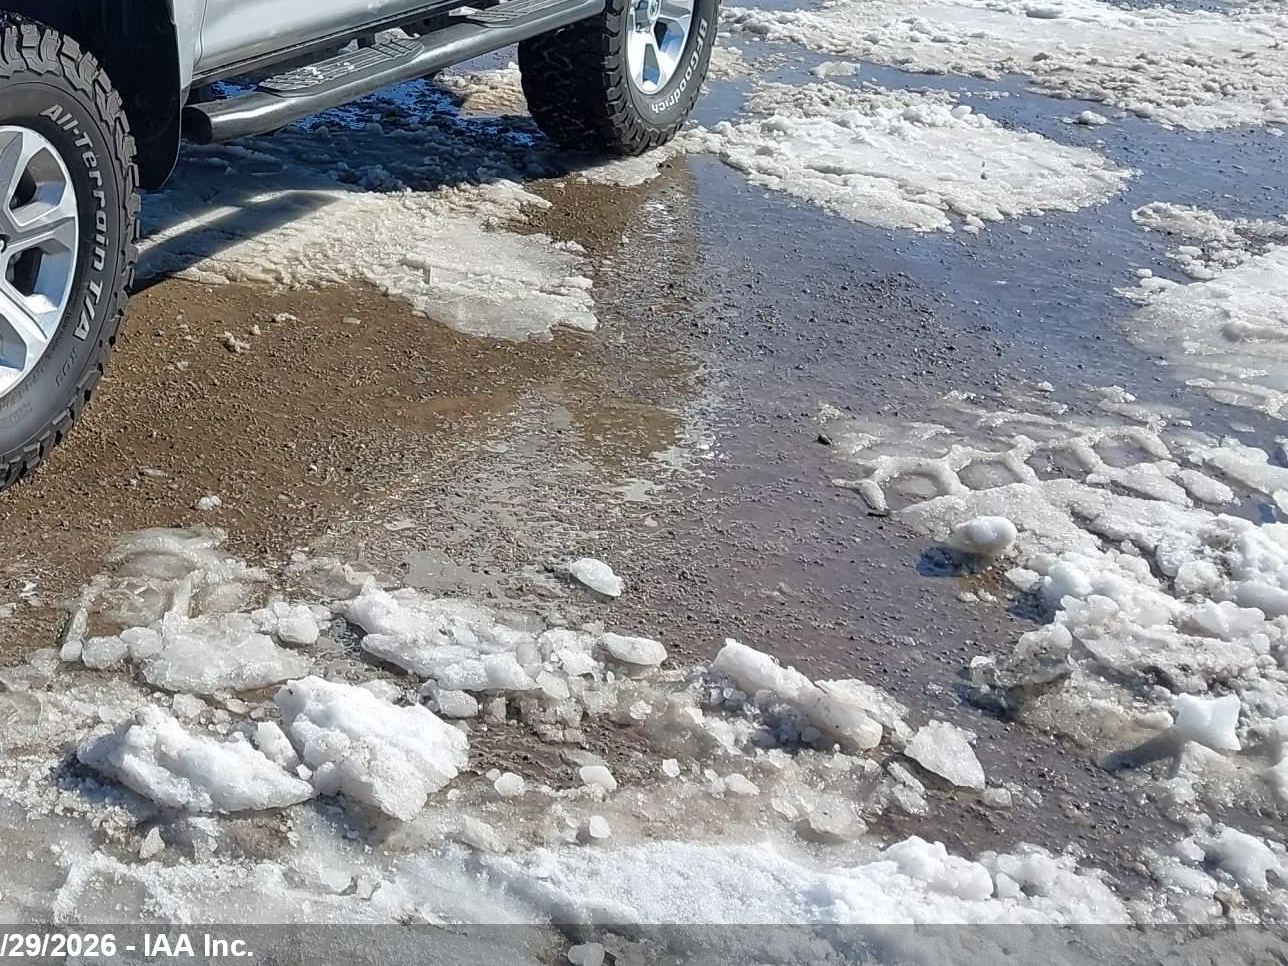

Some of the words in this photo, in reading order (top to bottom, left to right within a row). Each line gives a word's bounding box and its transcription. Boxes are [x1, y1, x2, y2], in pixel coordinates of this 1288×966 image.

[651, 18, 709, 114] BFGoodrich
[39, 103, 110, 272] All-Terrain
[72, 281, 103, 341] T/A
